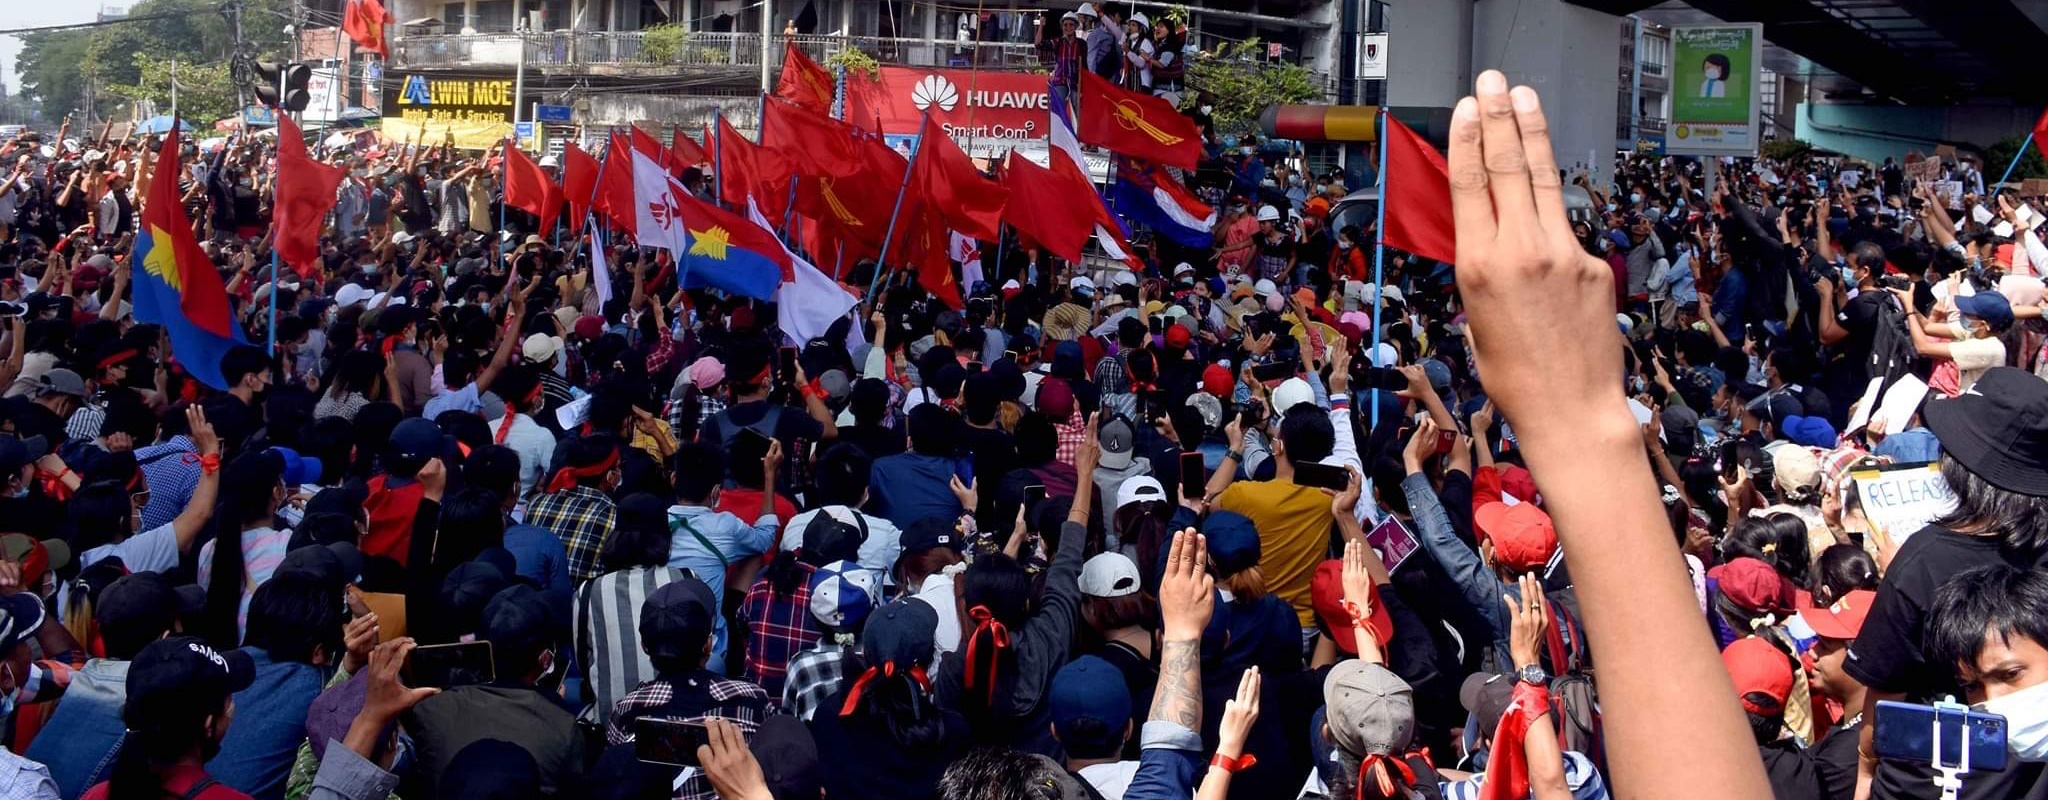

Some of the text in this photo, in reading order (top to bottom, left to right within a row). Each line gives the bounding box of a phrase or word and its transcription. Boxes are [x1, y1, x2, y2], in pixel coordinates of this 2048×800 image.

[431, 80, 512, 105] LWIN MOE
[966, 90, 1048, 109] HUAWE
[432, 109, 452, 121] Sale
[456, 109, 463, 120] &
[467, 110, 505, 123] Service
[942, 122, 988, 138] Smart
[961, 143, 995, 151] HAWEI
